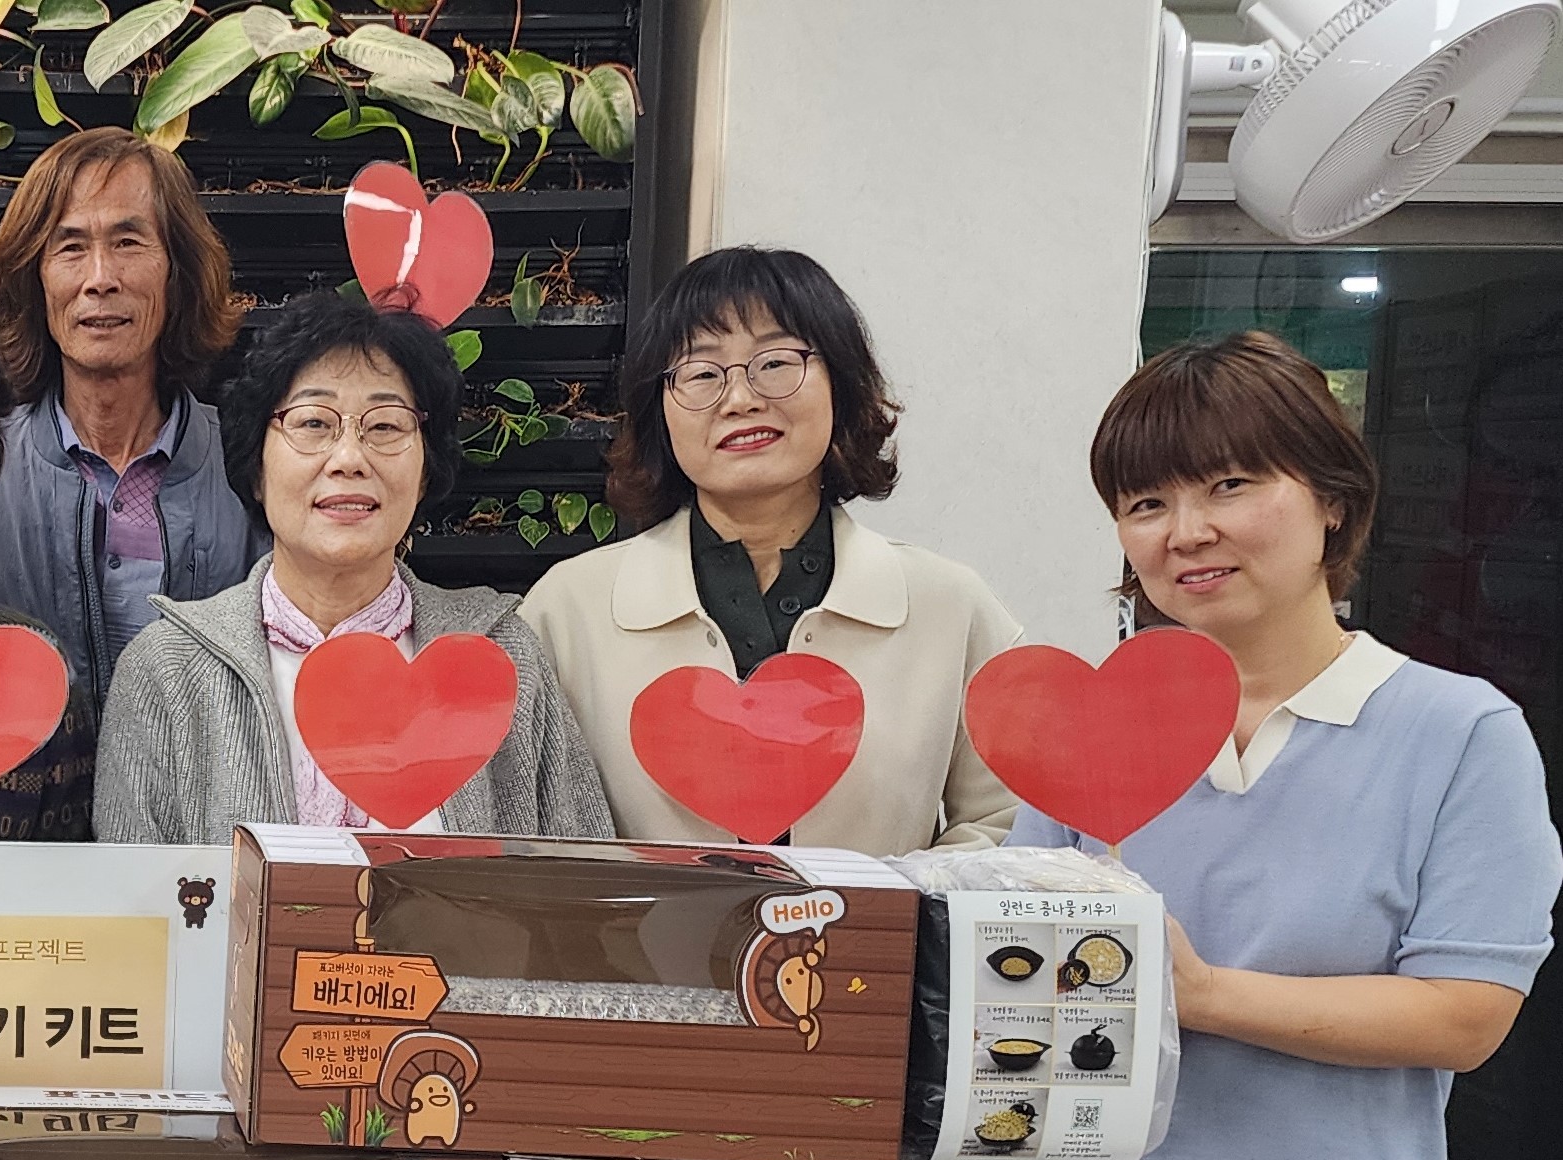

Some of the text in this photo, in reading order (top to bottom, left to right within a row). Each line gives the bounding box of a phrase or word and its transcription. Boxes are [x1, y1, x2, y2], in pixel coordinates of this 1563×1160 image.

[773, 897, 834, 922] Hello
[999, 900, 1117, 918] 일런드 콩나물 키우기
[319, 963, 394, 978] 표고버섯이 자라는
[314, 978, 416, 1010] 배지에요!
[44, 1003, 144, 1057] 키트
[302, 1045, 383, 1062] 키우는 방법이
[322, 1064, 363, 1081] 있어요!
